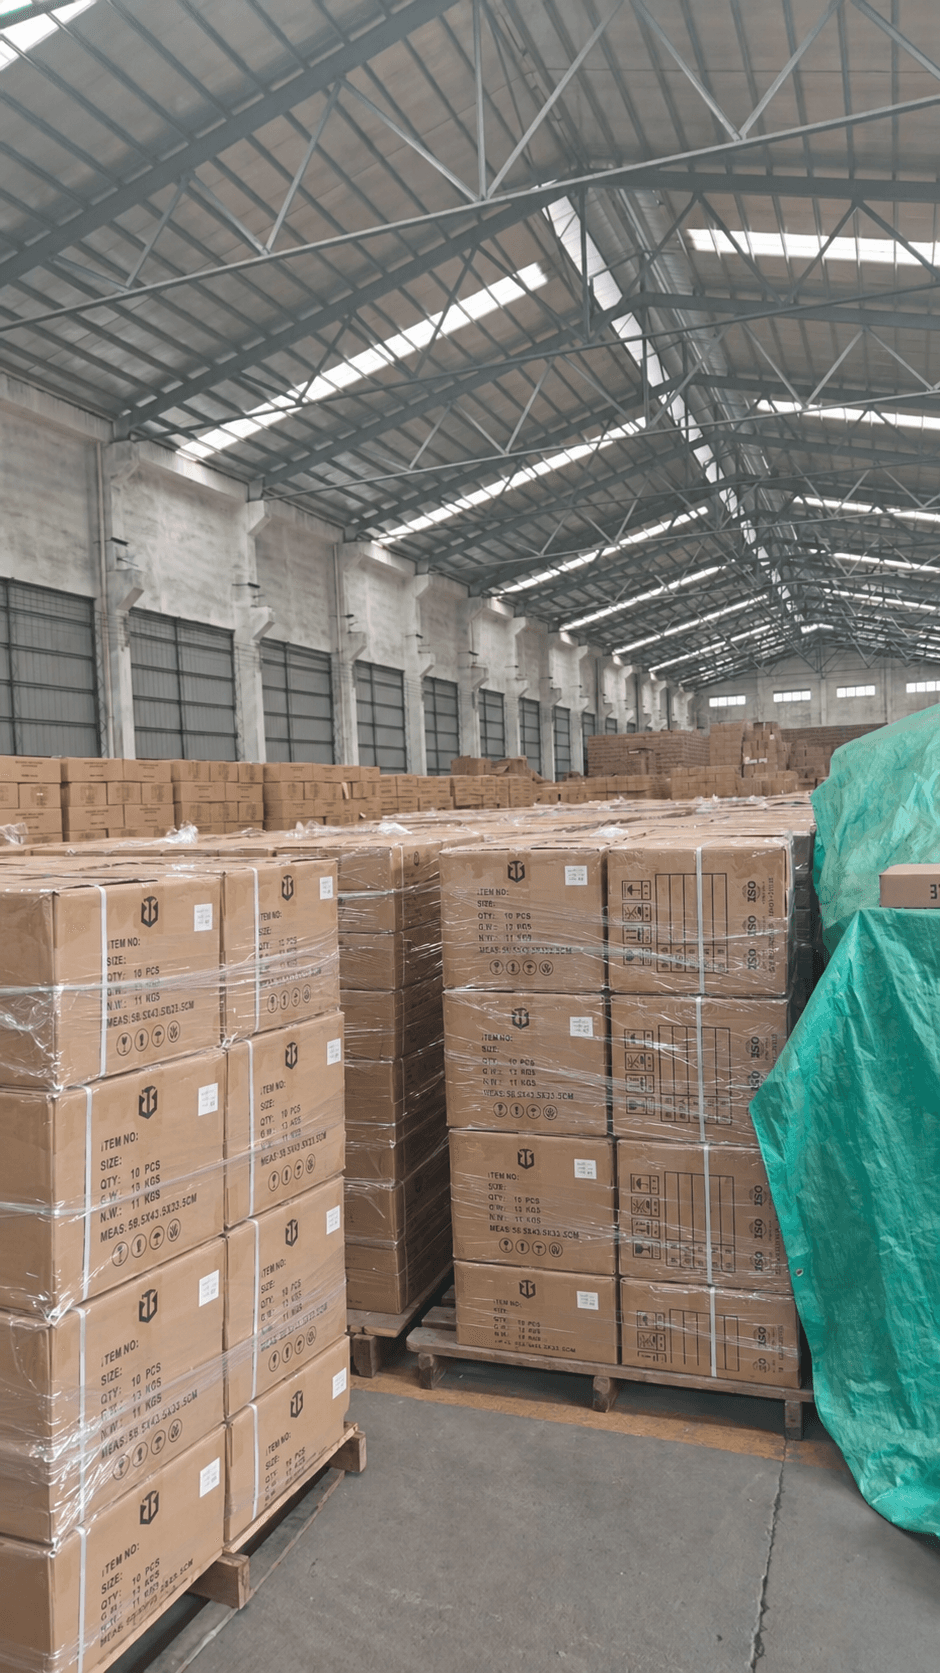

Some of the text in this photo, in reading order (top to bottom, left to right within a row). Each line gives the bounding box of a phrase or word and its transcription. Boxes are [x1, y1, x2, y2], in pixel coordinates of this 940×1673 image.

[747, 881, 757, 903] ISO
[477, 912, 531, 920] QTY: 10 PCS
[747, 915, 757, 936] ISO
[107, 956, 126, 966] SIZE:
[146, 966, 160, 975] PCS
[750, 1036, 760, 1059] ISO
[101, 1132, 139, 1152] ITEM NO:
[100, 1156, 122, 1171] SIZE:
[100, 1160, 161, 1190] QTY: 10 PCS
[144, 1174, 161, 1188] KGS
[488, 1171, 520, 1181] ITEM NO:
[100, 1189, 161, 1223] N.W.: 11 KGS
[754, 1185, 763, 1206] ISO
[754, 1219, 763, 1239] ISO
[101, 1340, 139, 1367] ITEM NO:
[101, 1367, 122, 1386] SIZE:
[101, 1362, 161, 1404] QTY: 10 PCS
[145, 1393, 162, 1411] KGS
[102, 1543, 139, 1577] ITEM NO:
[132, 1573, 141, 1586] 10
[145, 1558, 159, 1576] PCS
[101, 1572, 123, 1595] SIZE:
